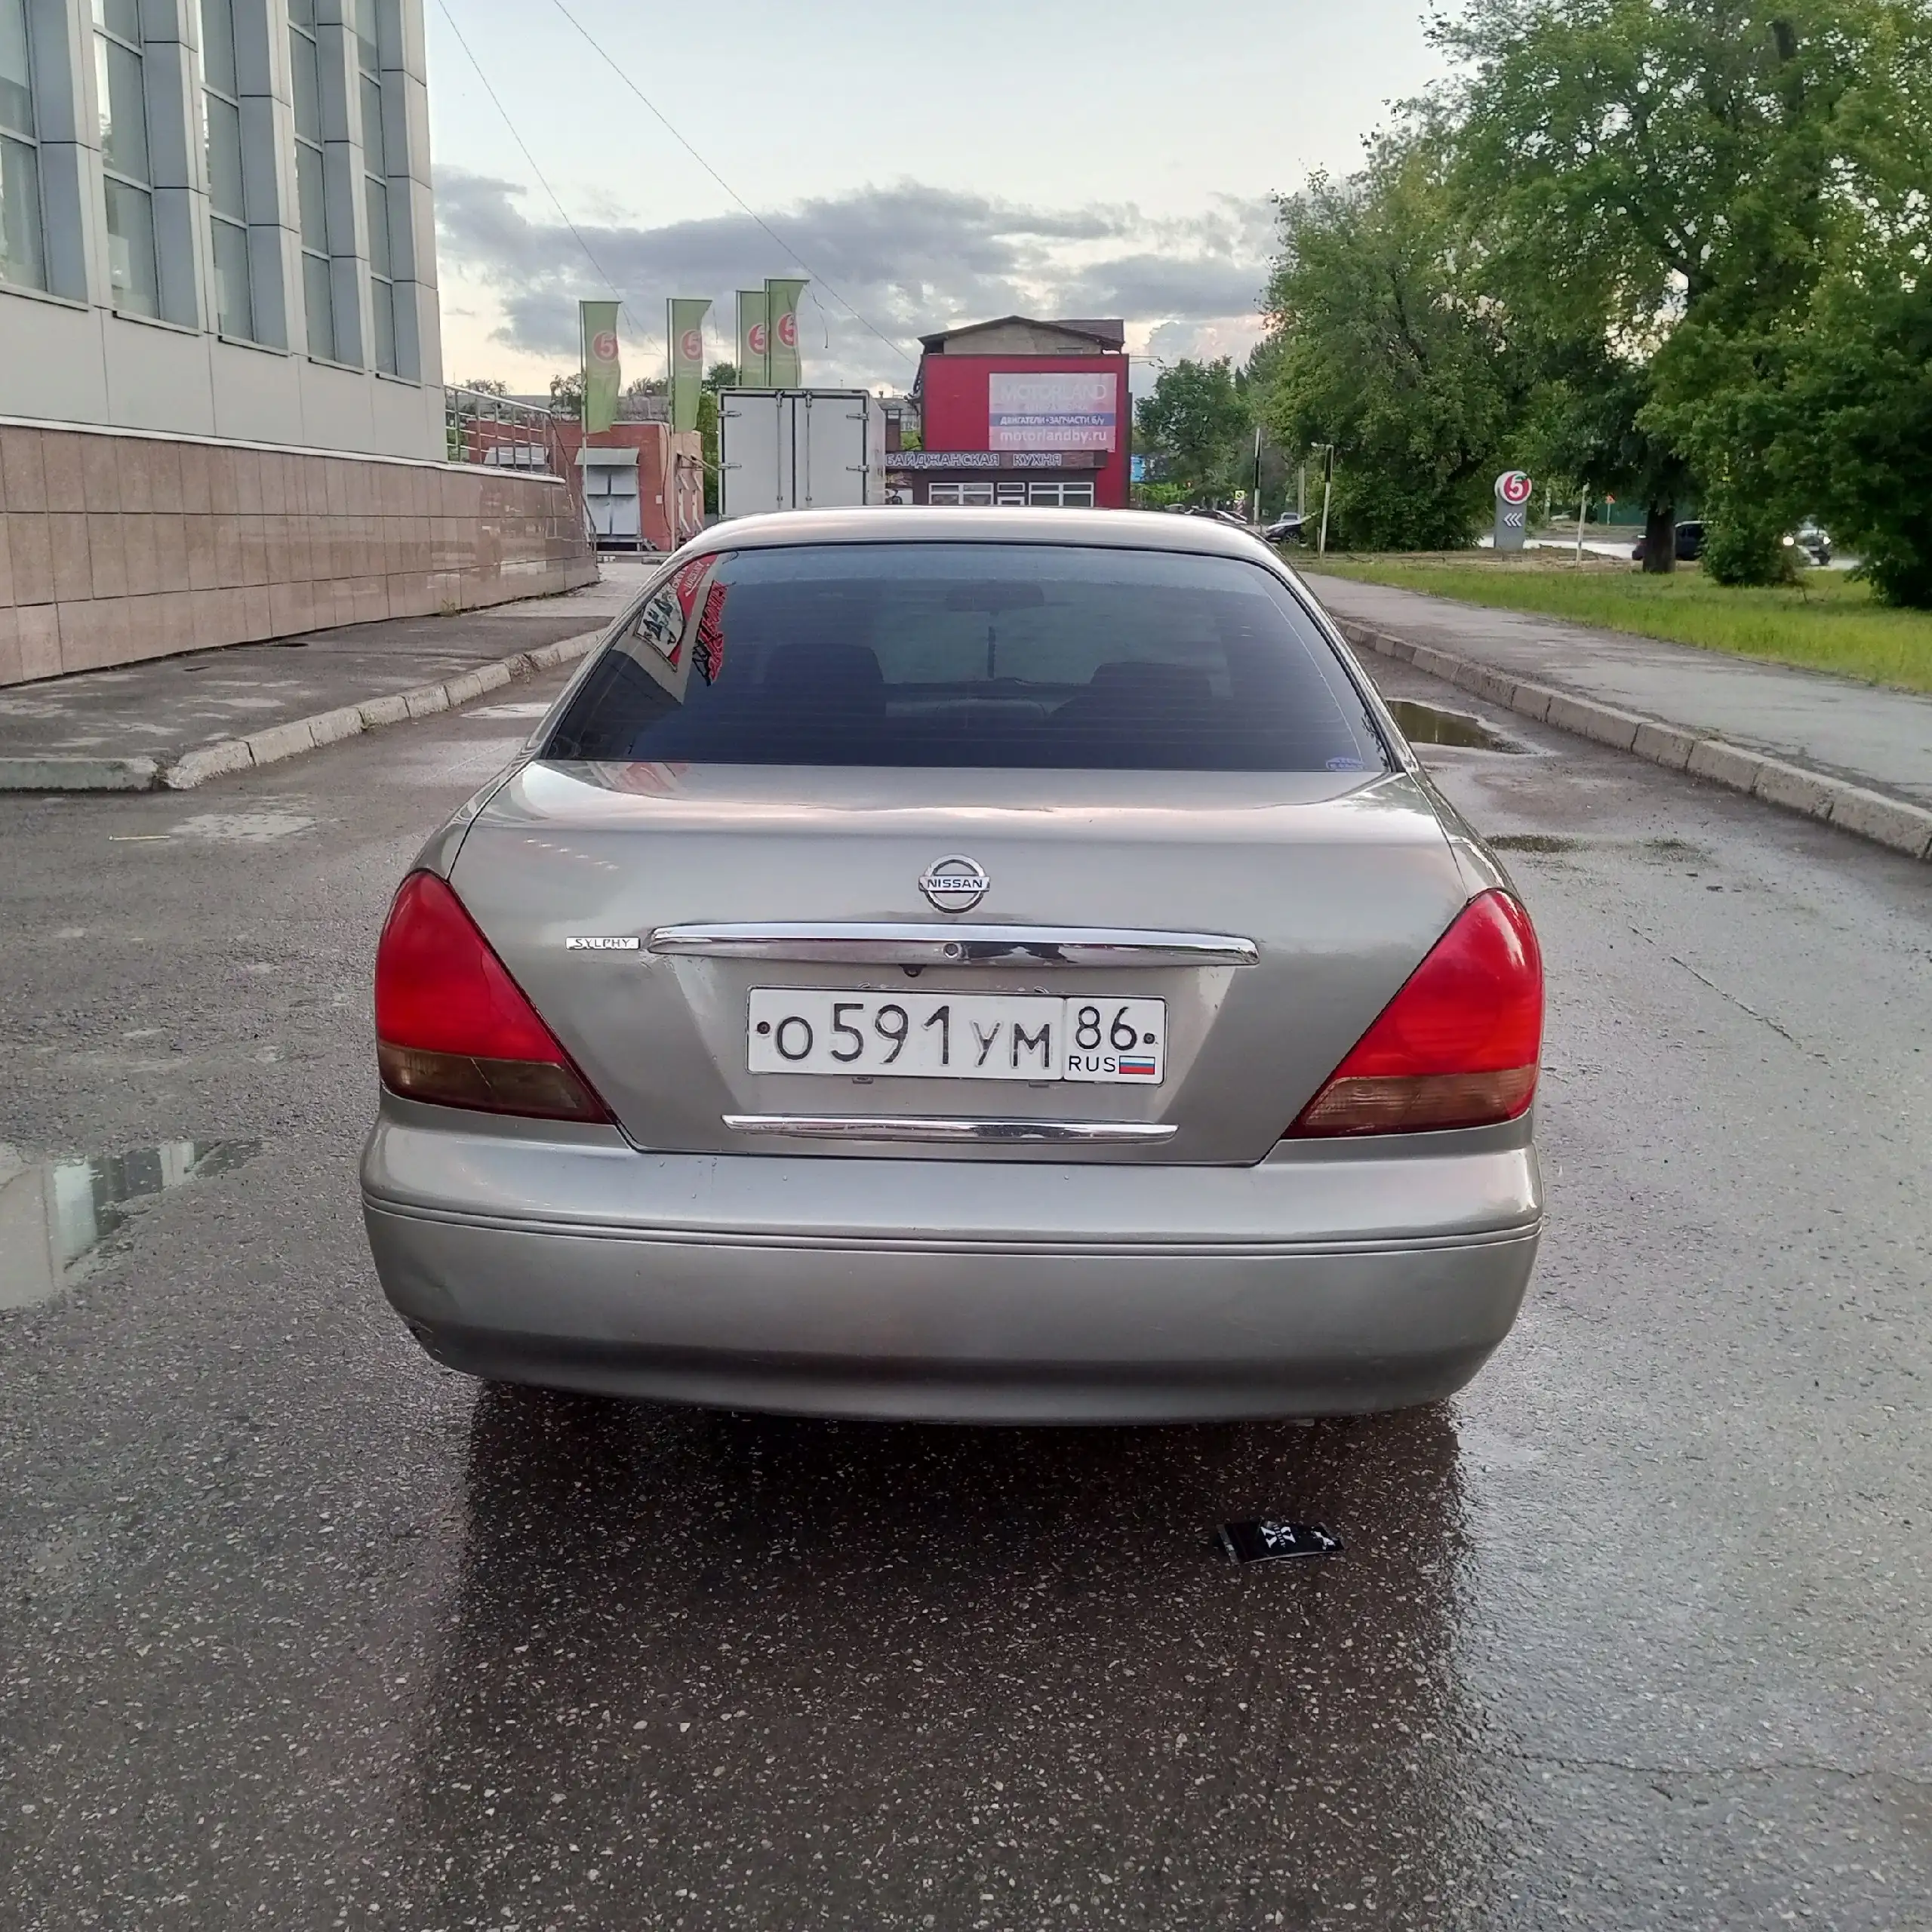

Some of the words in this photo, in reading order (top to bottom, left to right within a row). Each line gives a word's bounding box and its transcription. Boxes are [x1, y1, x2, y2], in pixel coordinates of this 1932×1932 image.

[600, 331, 616, 358] 5
[686, 331, 702, 355] 5
[1000, 383, 1106, 400] MOTORLAND
[1000, 429, 1107, 445] motorlandby.ru
[1013, 453, 1063, 466] КУХНЯ
[1509, 475, 1525, 497] 5
[927, 878, 983, 888] NISSAN
[574, 938, 630, 948] SYLPHY
[1075, 1005, 1138, 1051] 86
[1068, 1055, 1116, 1072] RUS
